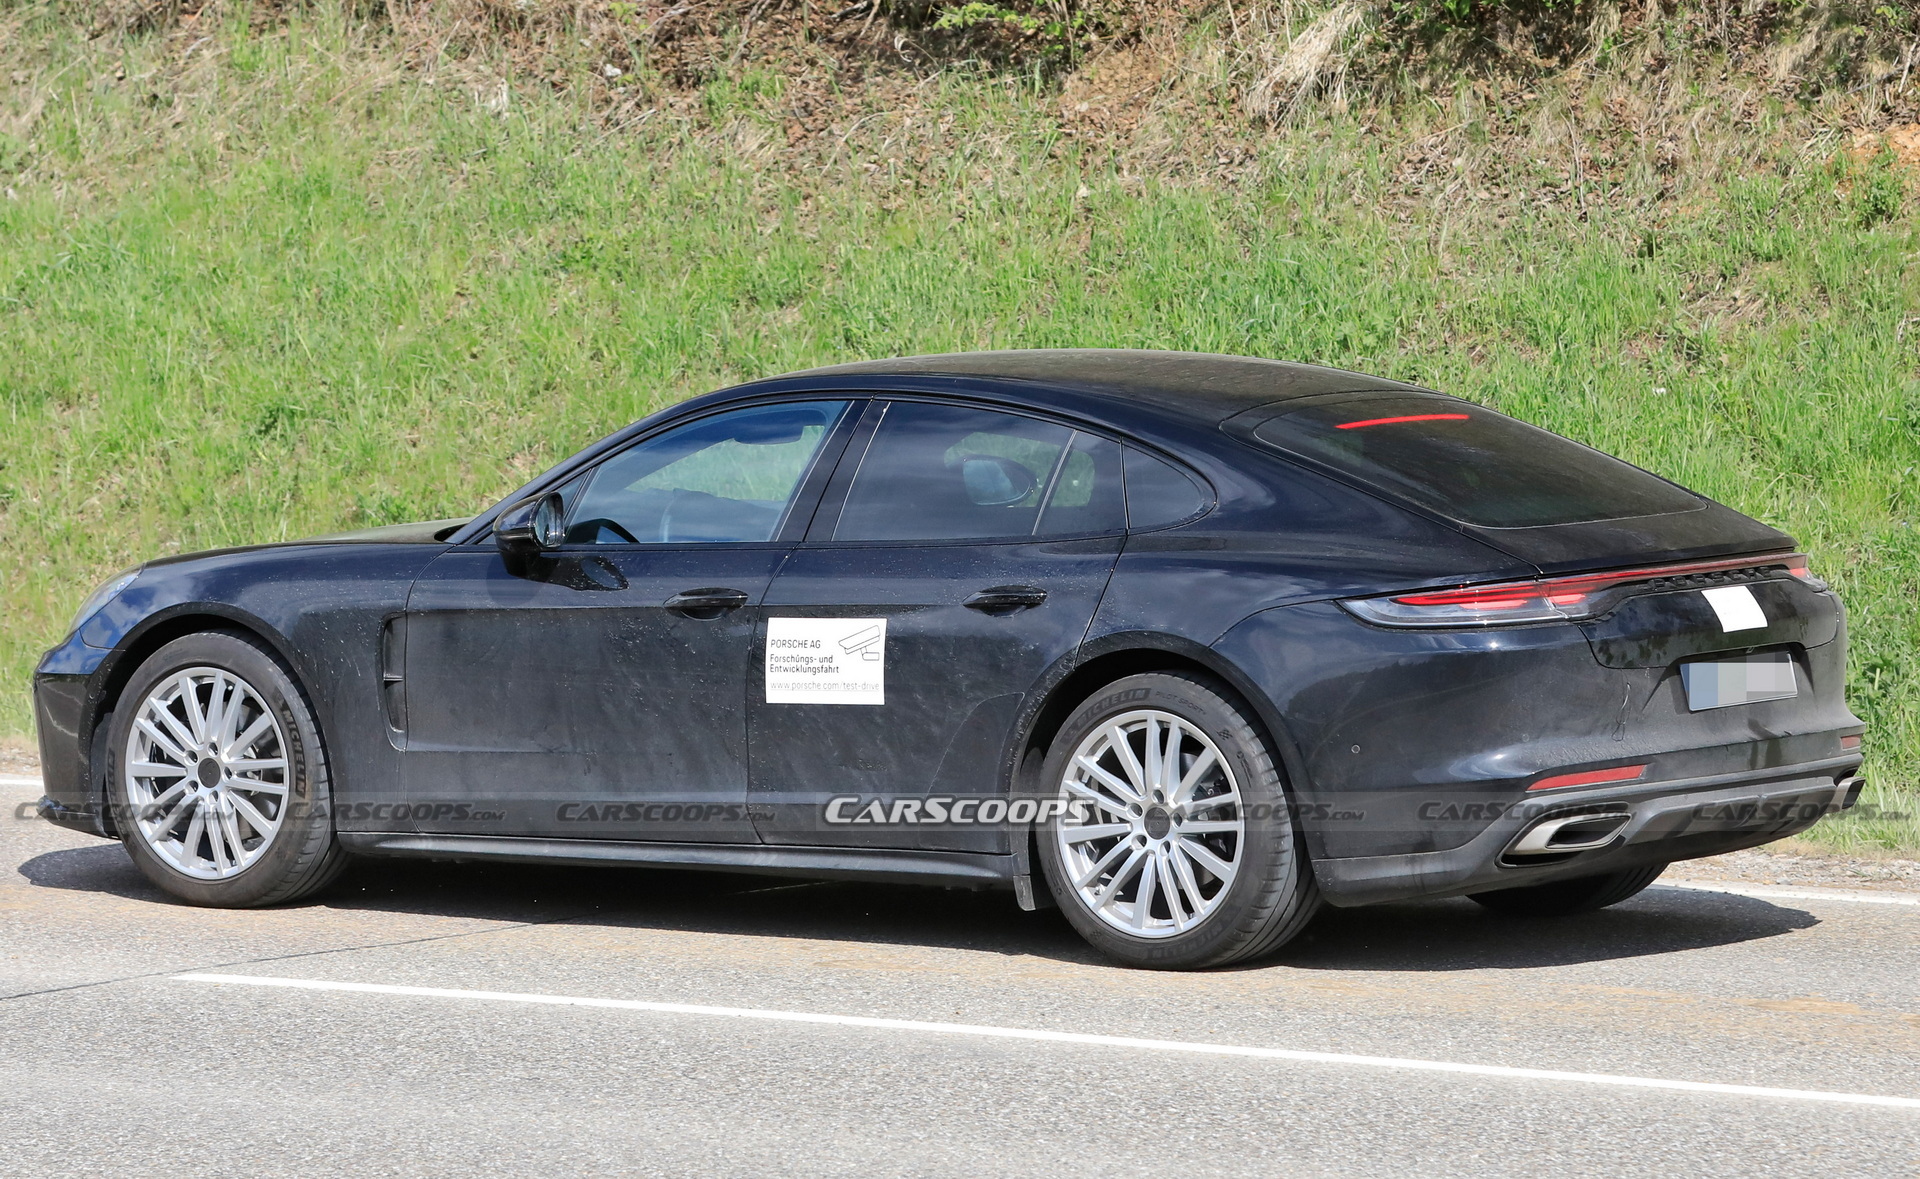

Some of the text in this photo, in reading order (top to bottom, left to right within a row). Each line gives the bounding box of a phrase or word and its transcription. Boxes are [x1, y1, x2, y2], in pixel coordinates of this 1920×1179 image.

[770, 639, 821, 649] PORSCHE AG
[819, 654, 833, 663] und
[770, 664, 839, 675] Entwicklungsfahrt
[770, 681, 879, 690] www.porsche.com/test-drive
[1076, 688, 1148, 728] MICHELIN
[282, 708, 307, 798] MICHELIN
